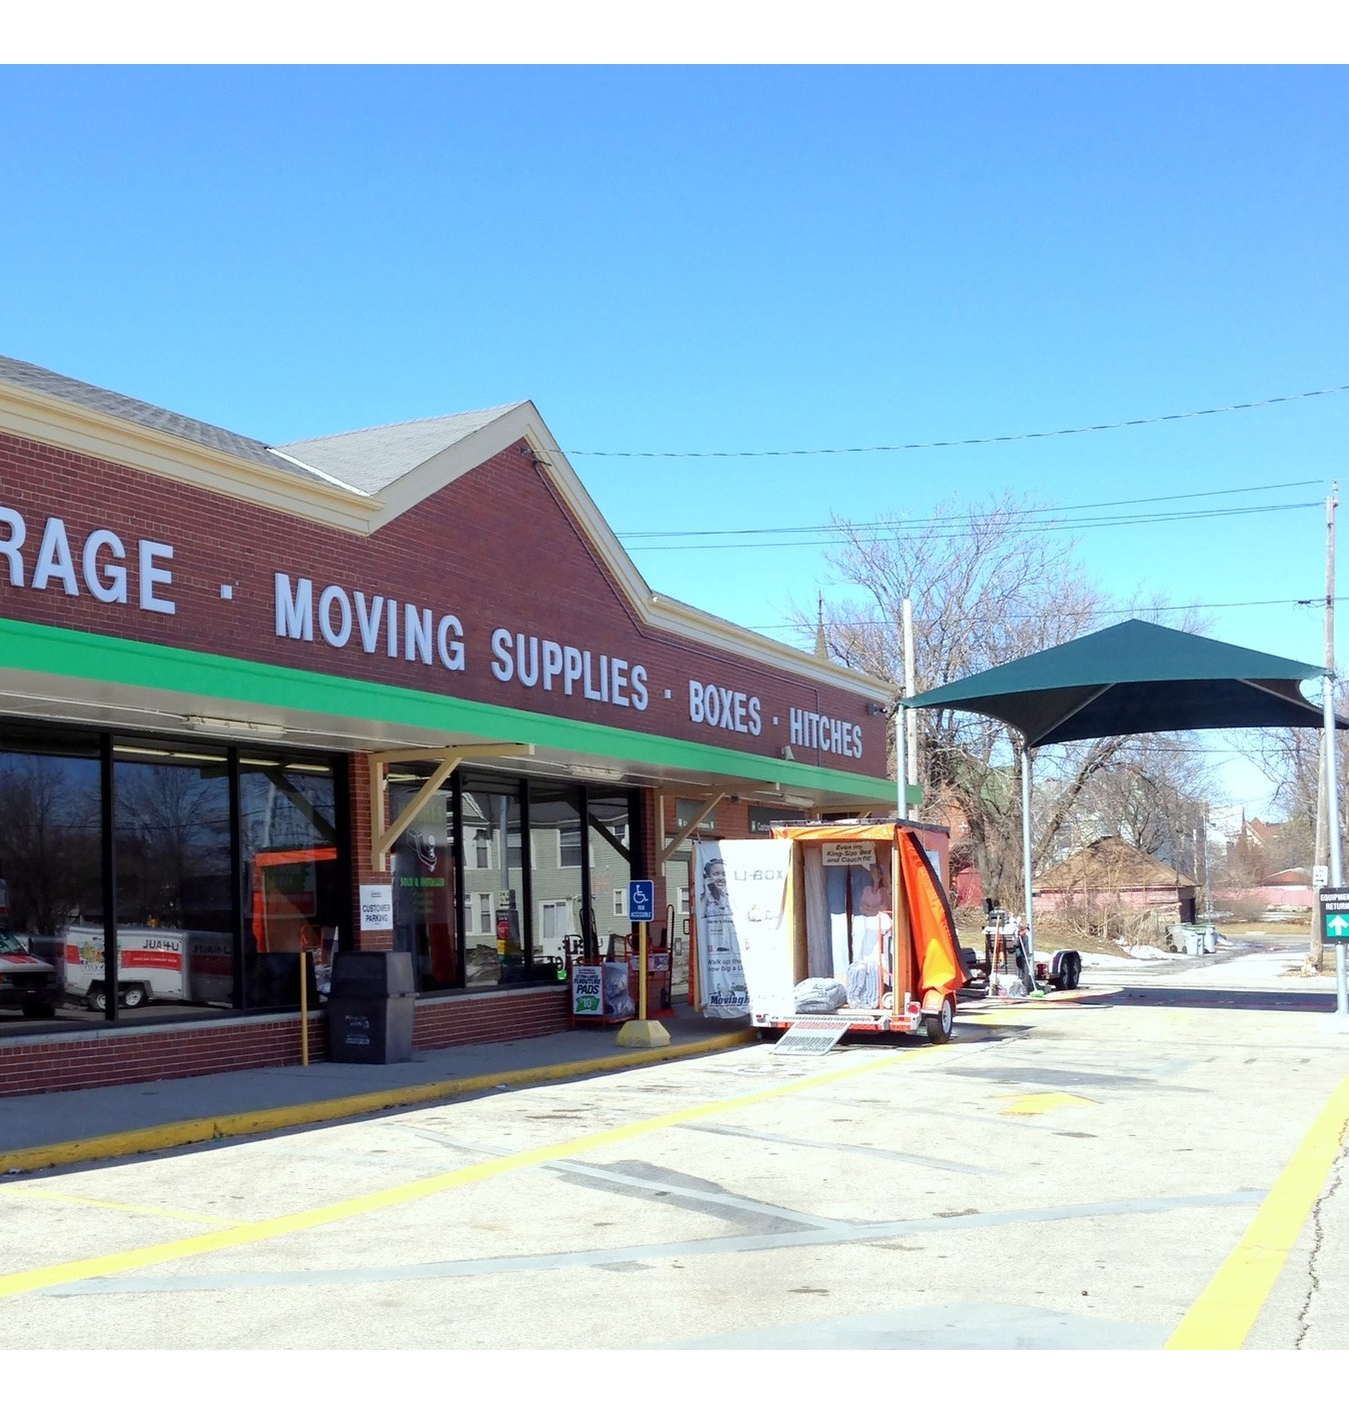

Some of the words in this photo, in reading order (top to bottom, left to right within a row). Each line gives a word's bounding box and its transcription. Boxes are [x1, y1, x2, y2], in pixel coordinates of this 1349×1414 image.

[274, 572, 465, 672] MOVING
[491, 627, 649, 711] SUPPLIES
[688, 679, 762, 736] BOXES
[789, 707, 863, 758] HITCHES
[362, 904, 391, 913] CUSTOMER
[366, 914, 389, 923] PARKING
[576, 984, 600, 994] PADS
